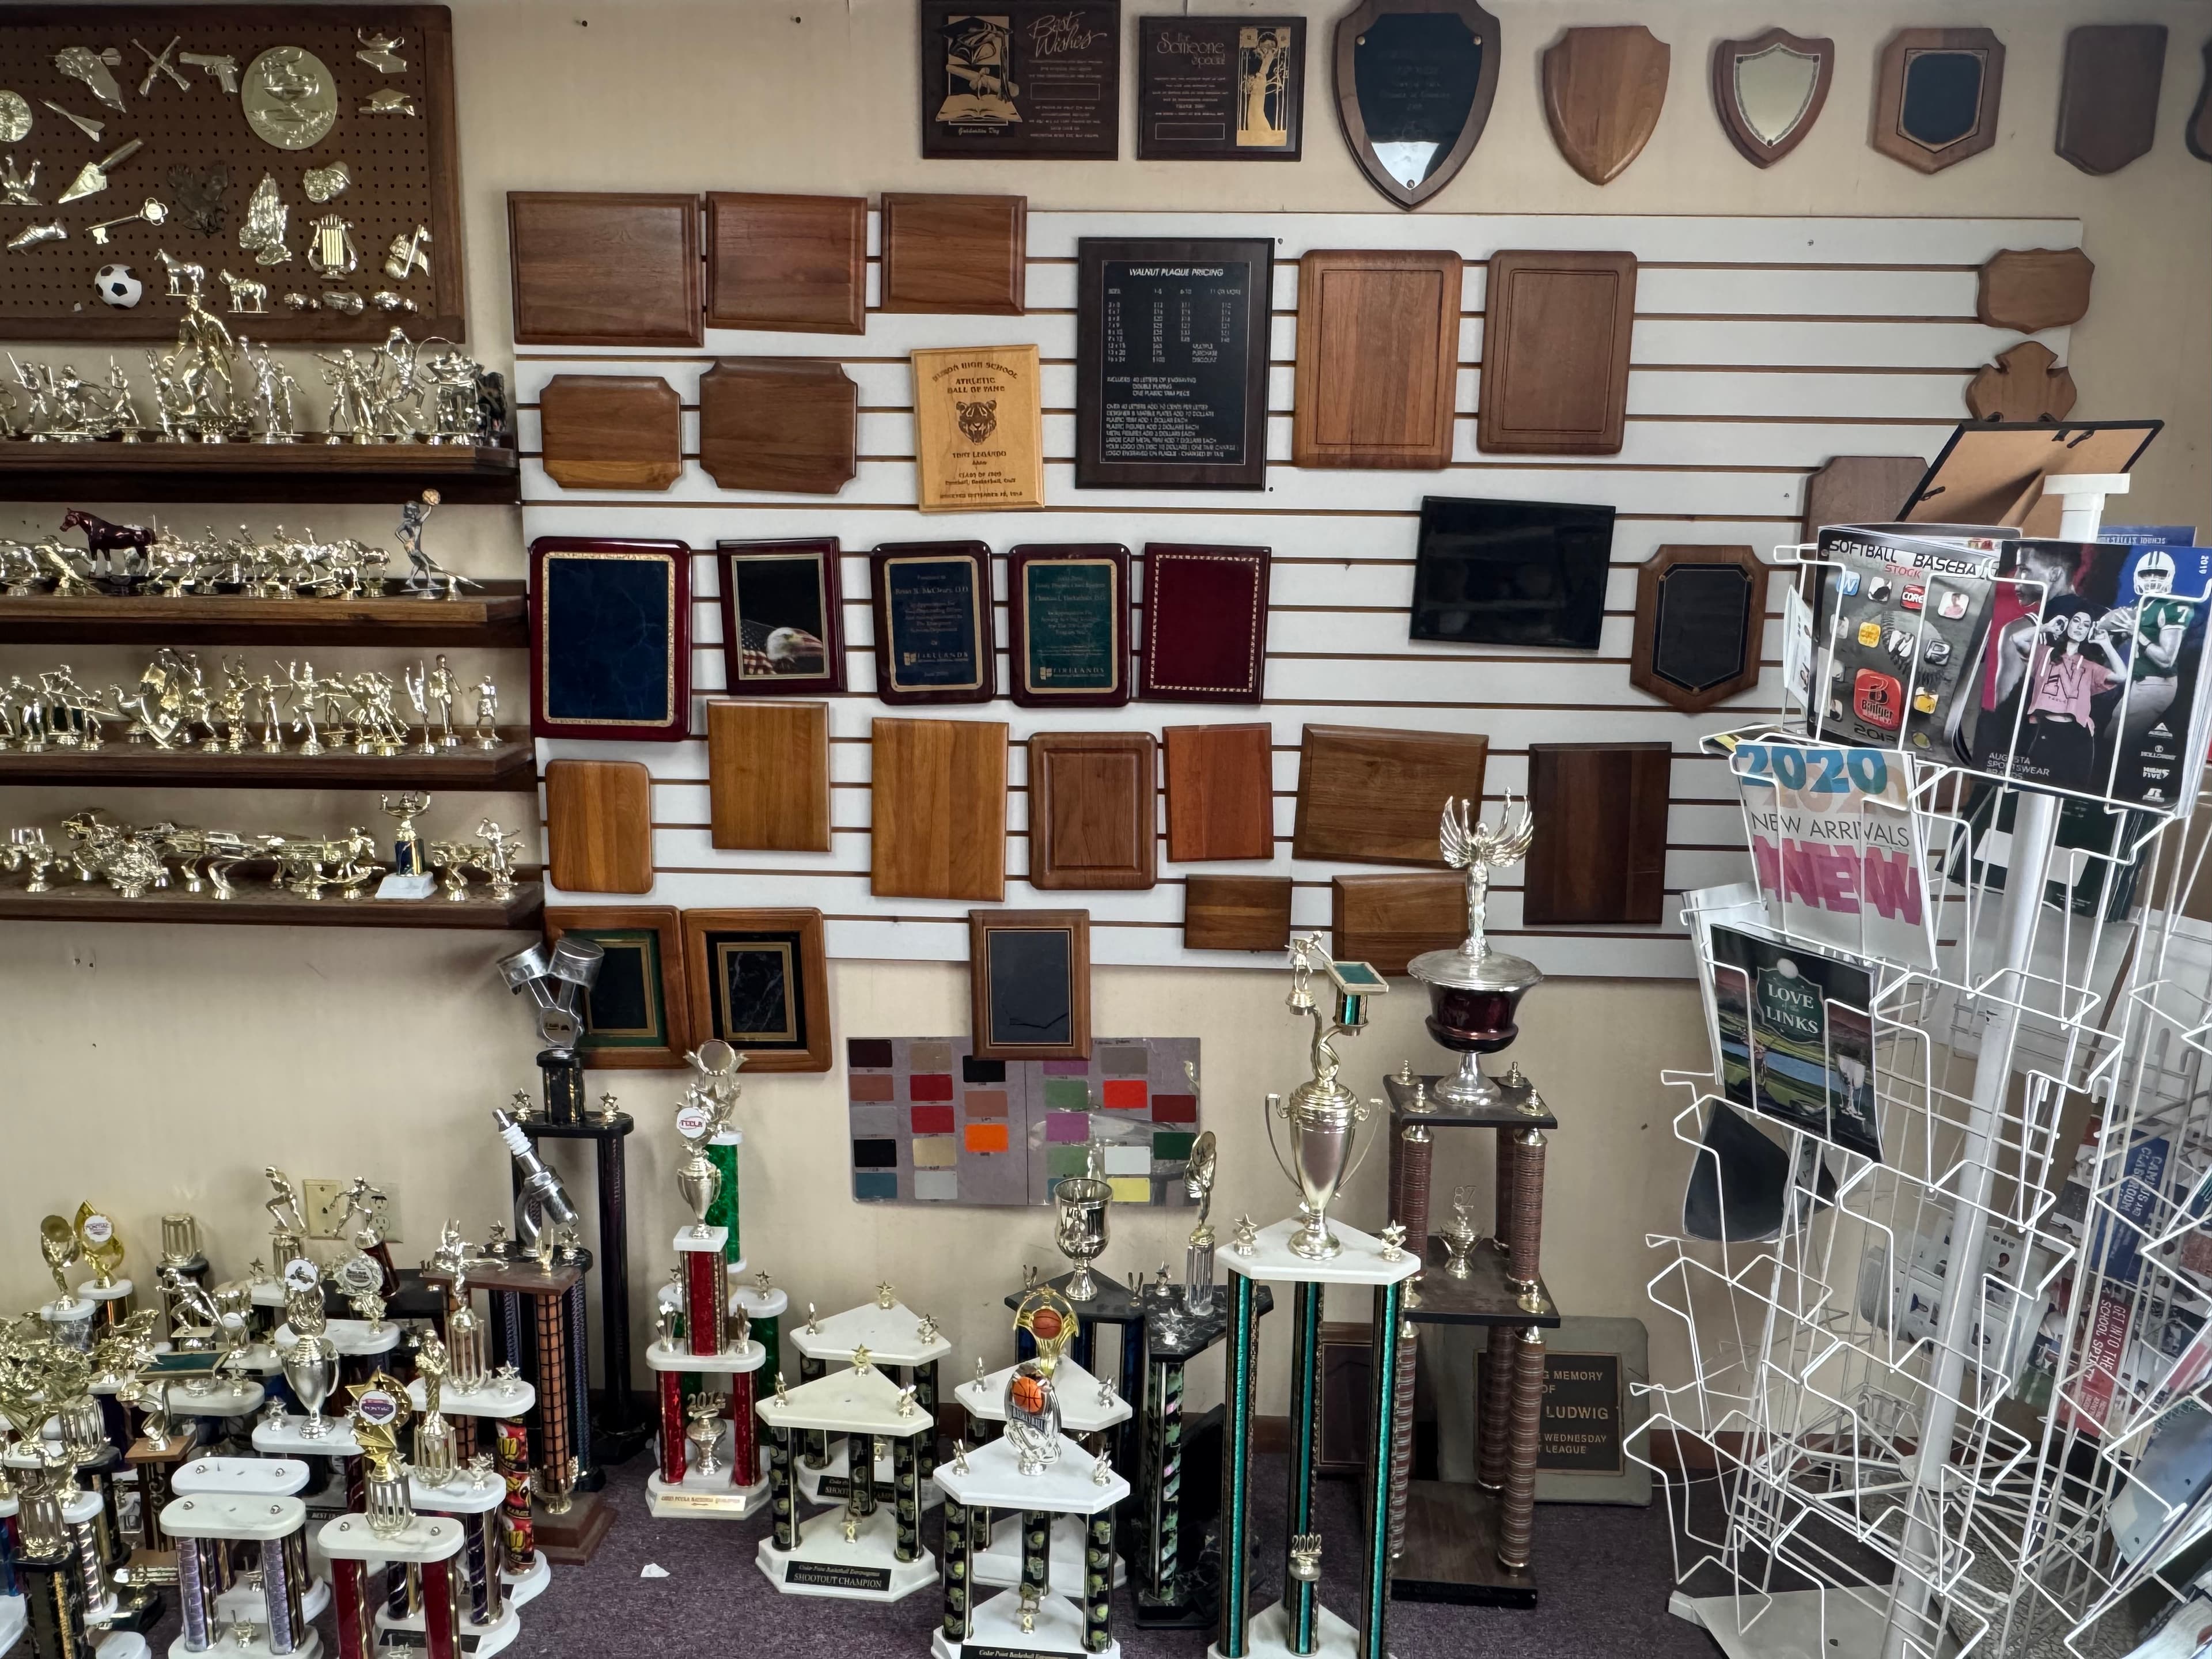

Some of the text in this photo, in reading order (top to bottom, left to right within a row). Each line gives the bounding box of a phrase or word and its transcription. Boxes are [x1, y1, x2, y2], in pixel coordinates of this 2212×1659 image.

[1027, 11, 1086, 39] Best
[1036, 19, 1107, 58] Wishes
[1157, 32, 1225, 54] Someone
[1130, 268, 1224, 277] WALNUT PLAQUE PRICING
[986, 362, 1018, 379] SCHOOL
[1830, 539, 1977, 575] SOFTBALL BASEBA
[1862, 699, 1893, 720] Badger
[1988, 752, 2031, 765] AUGSTA
[1736, 745, 1888, 795] 2020
[1986, 768, 2024, 779] BRADS
[1987, 760, 2050, 777] SPOTSWEAR
[1751, 812, 1910, 847] NEW ARRIVALS
[1768, 983, 1814, 1009] LOVE
[1766, 1005, 1819, 1033] LINKS
[2096, 1300, 2112, 1336] SCHOOL
[2100, 1305, 2126, 1371] GET INTO THE
[1554, 1370, 1603, 1381] MEMORY
[1541, 1384, 1556, 1393] OF
[1546, 1406, 1609, 1420] LUDWIG
[1544, 1433, 1607, 1443] WEDNESDAY
[1546, 1445, 1587, 1454] LEAGUE
[794, 1573, 838, 1584] SHOOTOUT
[838, 1577, 882, 1588] CHAMPION
